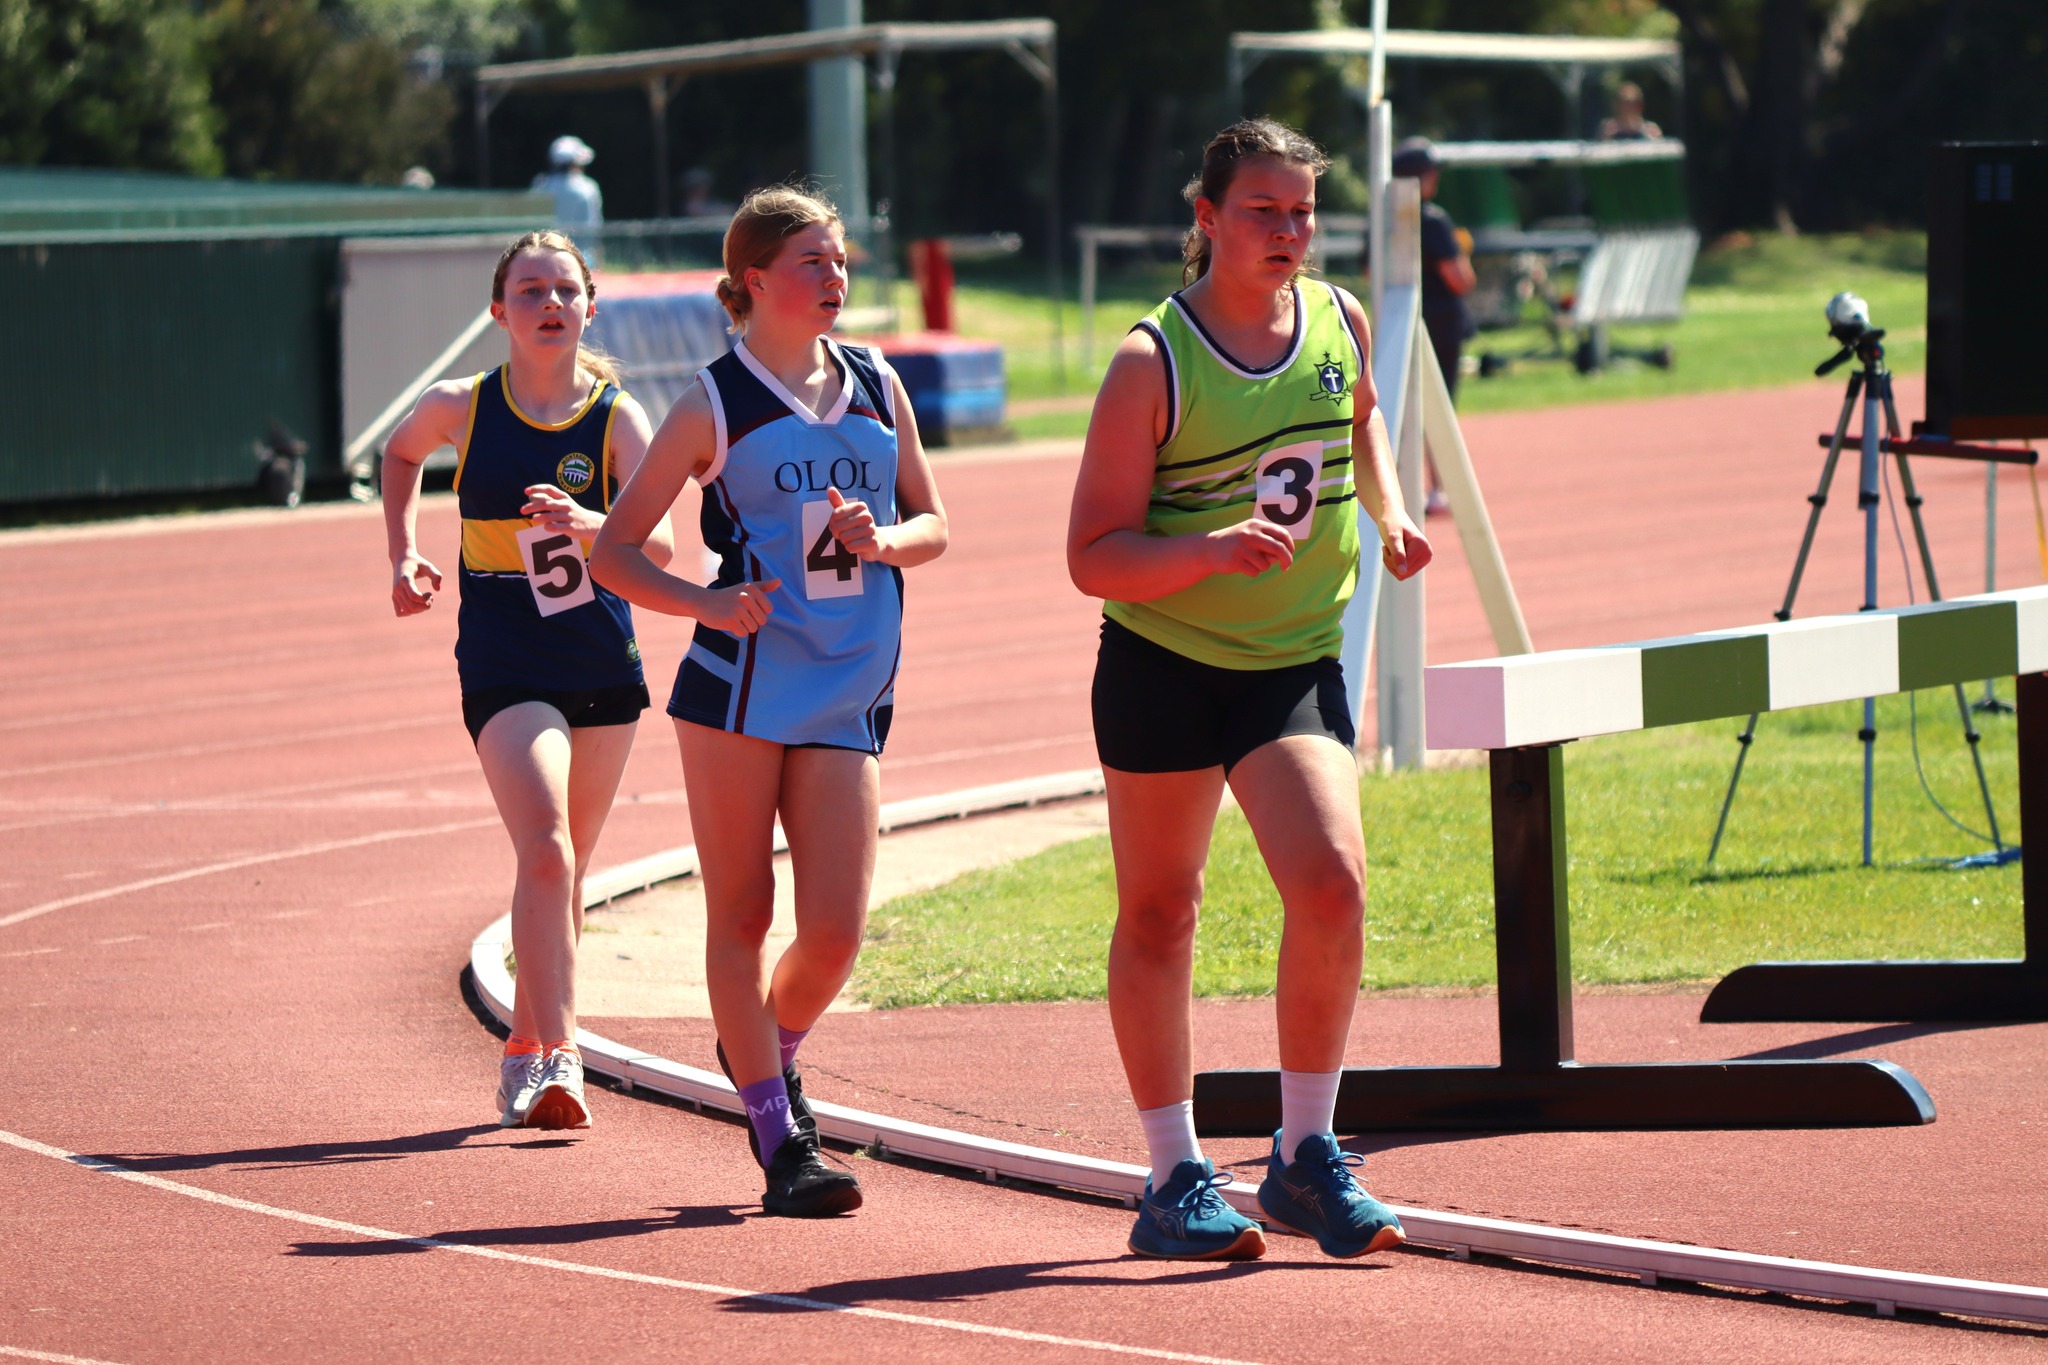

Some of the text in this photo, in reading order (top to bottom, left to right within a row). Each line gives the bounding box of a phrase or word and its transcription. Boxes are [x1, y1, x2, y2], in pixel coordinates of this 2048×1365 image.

[774, 457, 882, 493] OLOL
[1261, 456, 1315, 527] 3
[530, 533, 583, 599] 5
[806, 510, 859, 582] 4
